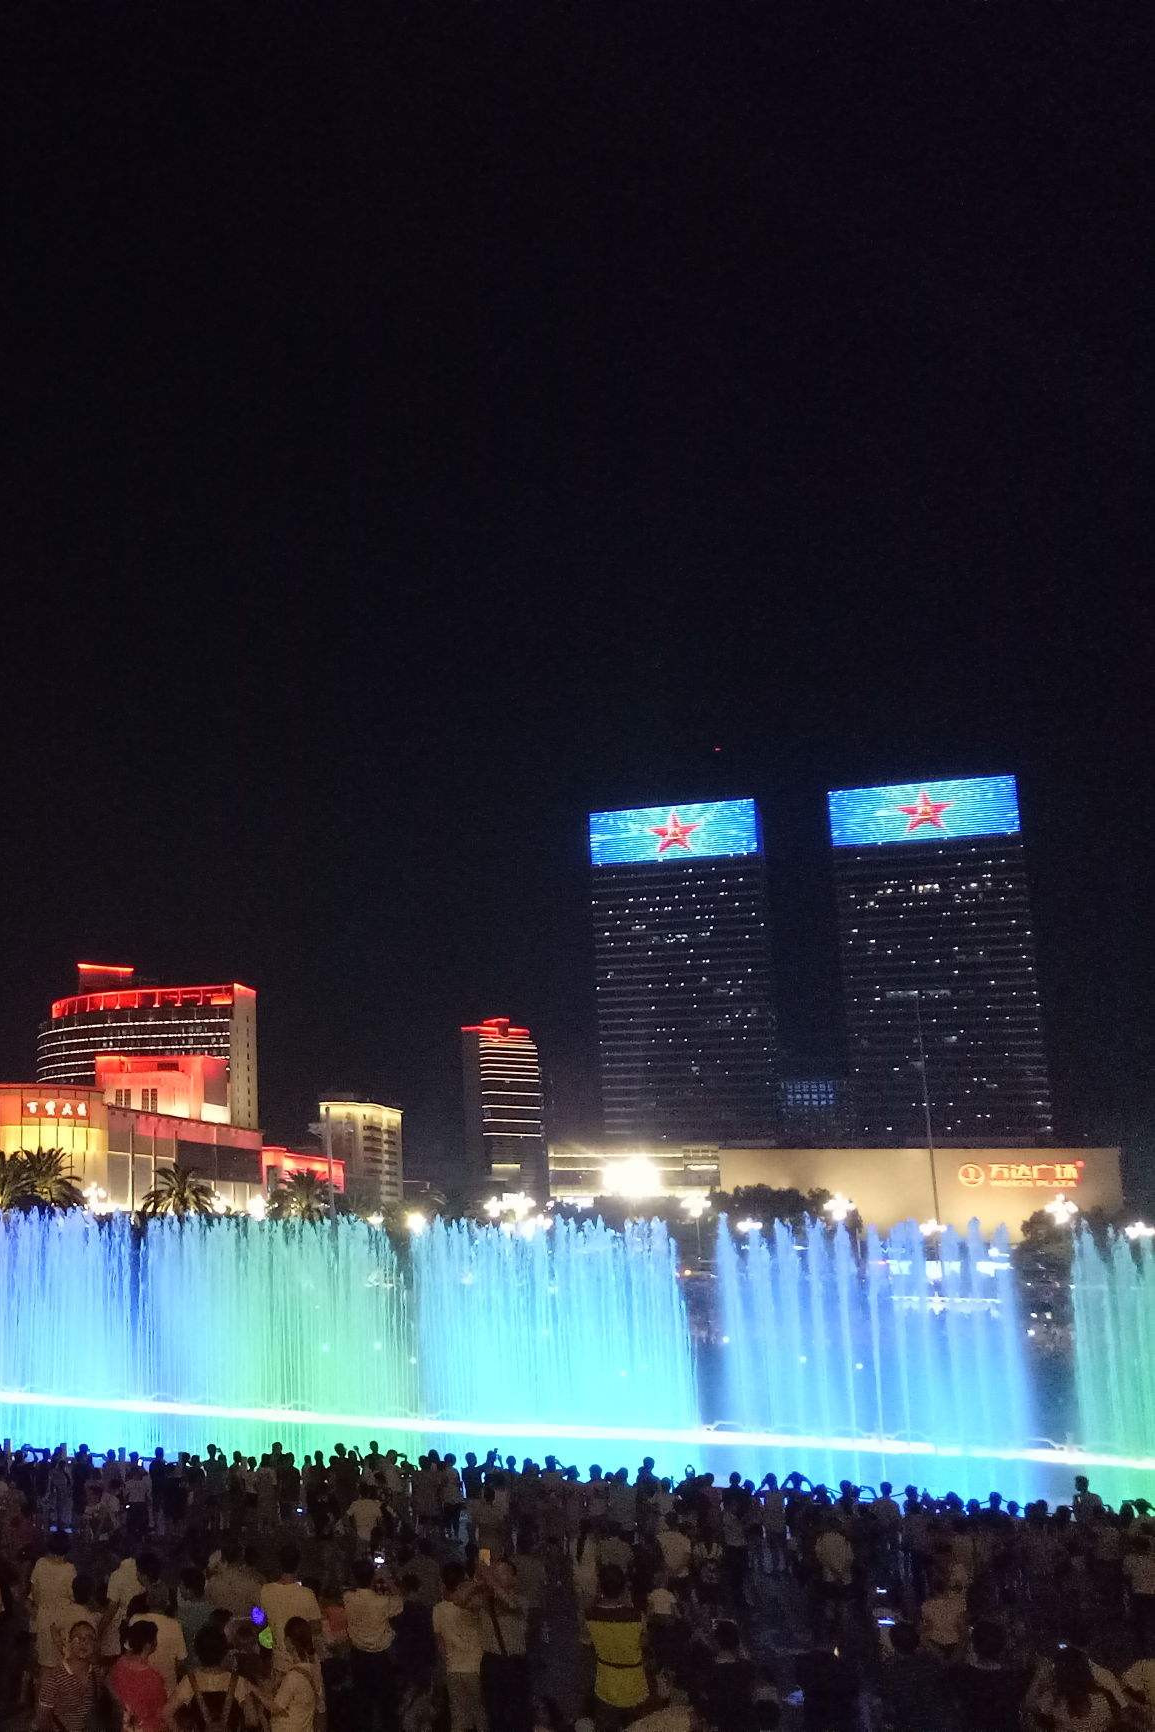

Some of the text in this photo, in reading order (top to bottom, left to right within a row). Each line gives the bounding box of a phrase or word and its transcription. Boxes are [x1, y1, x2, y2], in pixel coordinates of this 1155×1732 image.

[988, 1163, 1079, 1179] 万达广场
[1036, 1180, 1078, 1188] PLAZA
